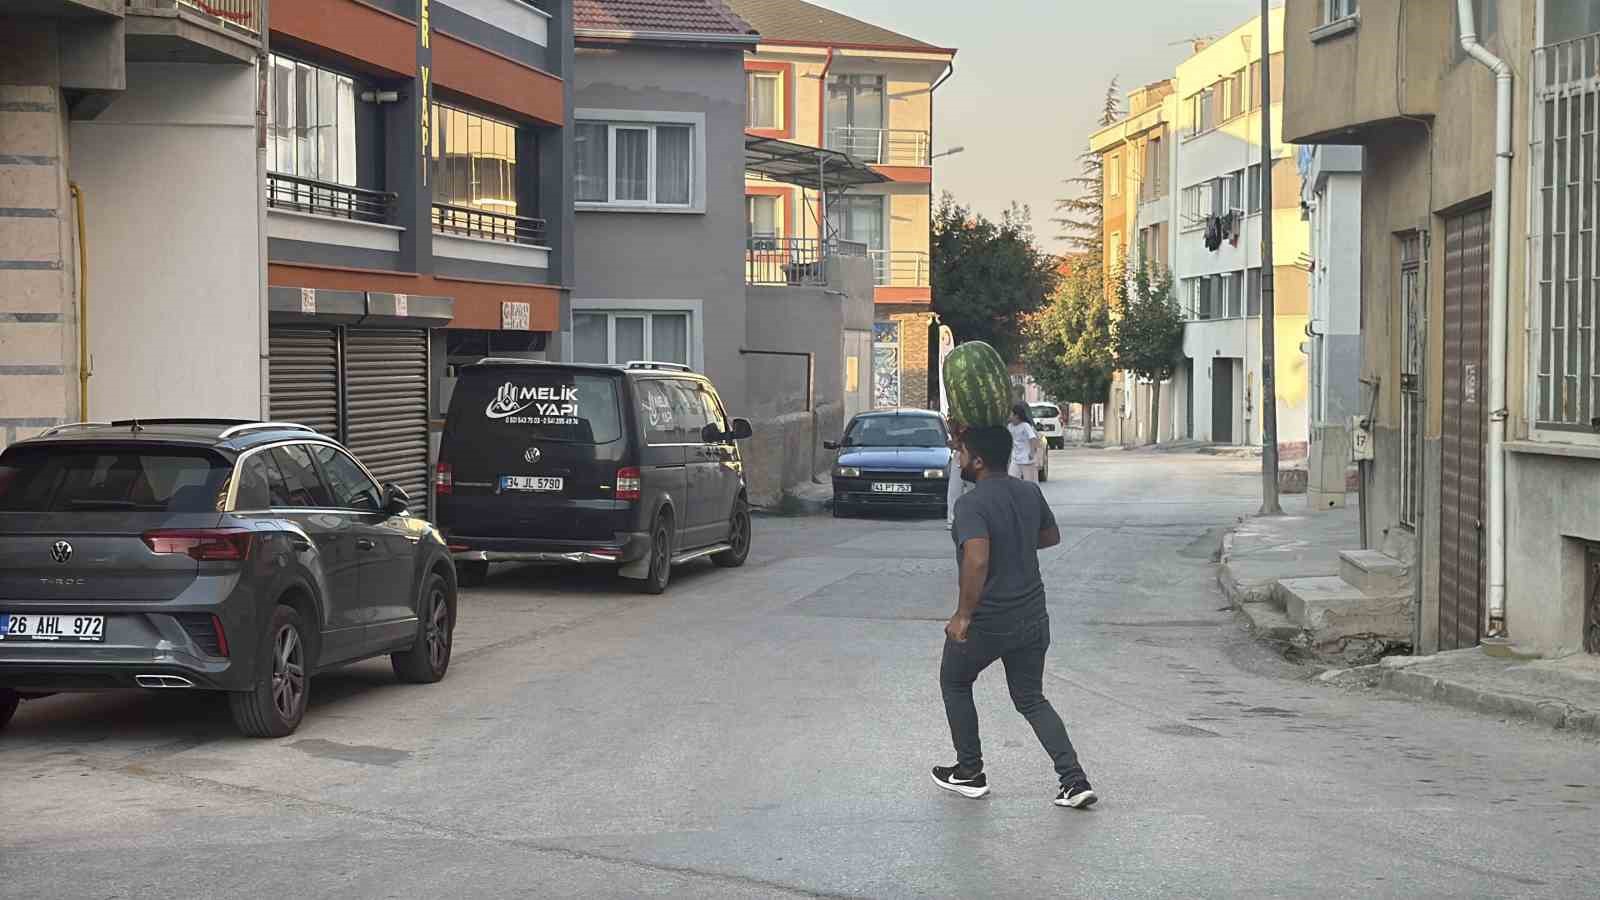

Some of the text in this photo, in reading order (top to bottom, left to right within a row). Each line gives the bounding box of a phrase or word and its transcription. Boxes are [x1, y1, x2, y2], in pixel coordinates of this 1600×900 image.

[421, 65, 429, 187] YAPI
[519, 384, 579, 401] MELİK
[535, 403, 578, 416] YAPI
[537, 478, 561, 489] 5790
[9, 616, 102, 635] 26 AHL 972
